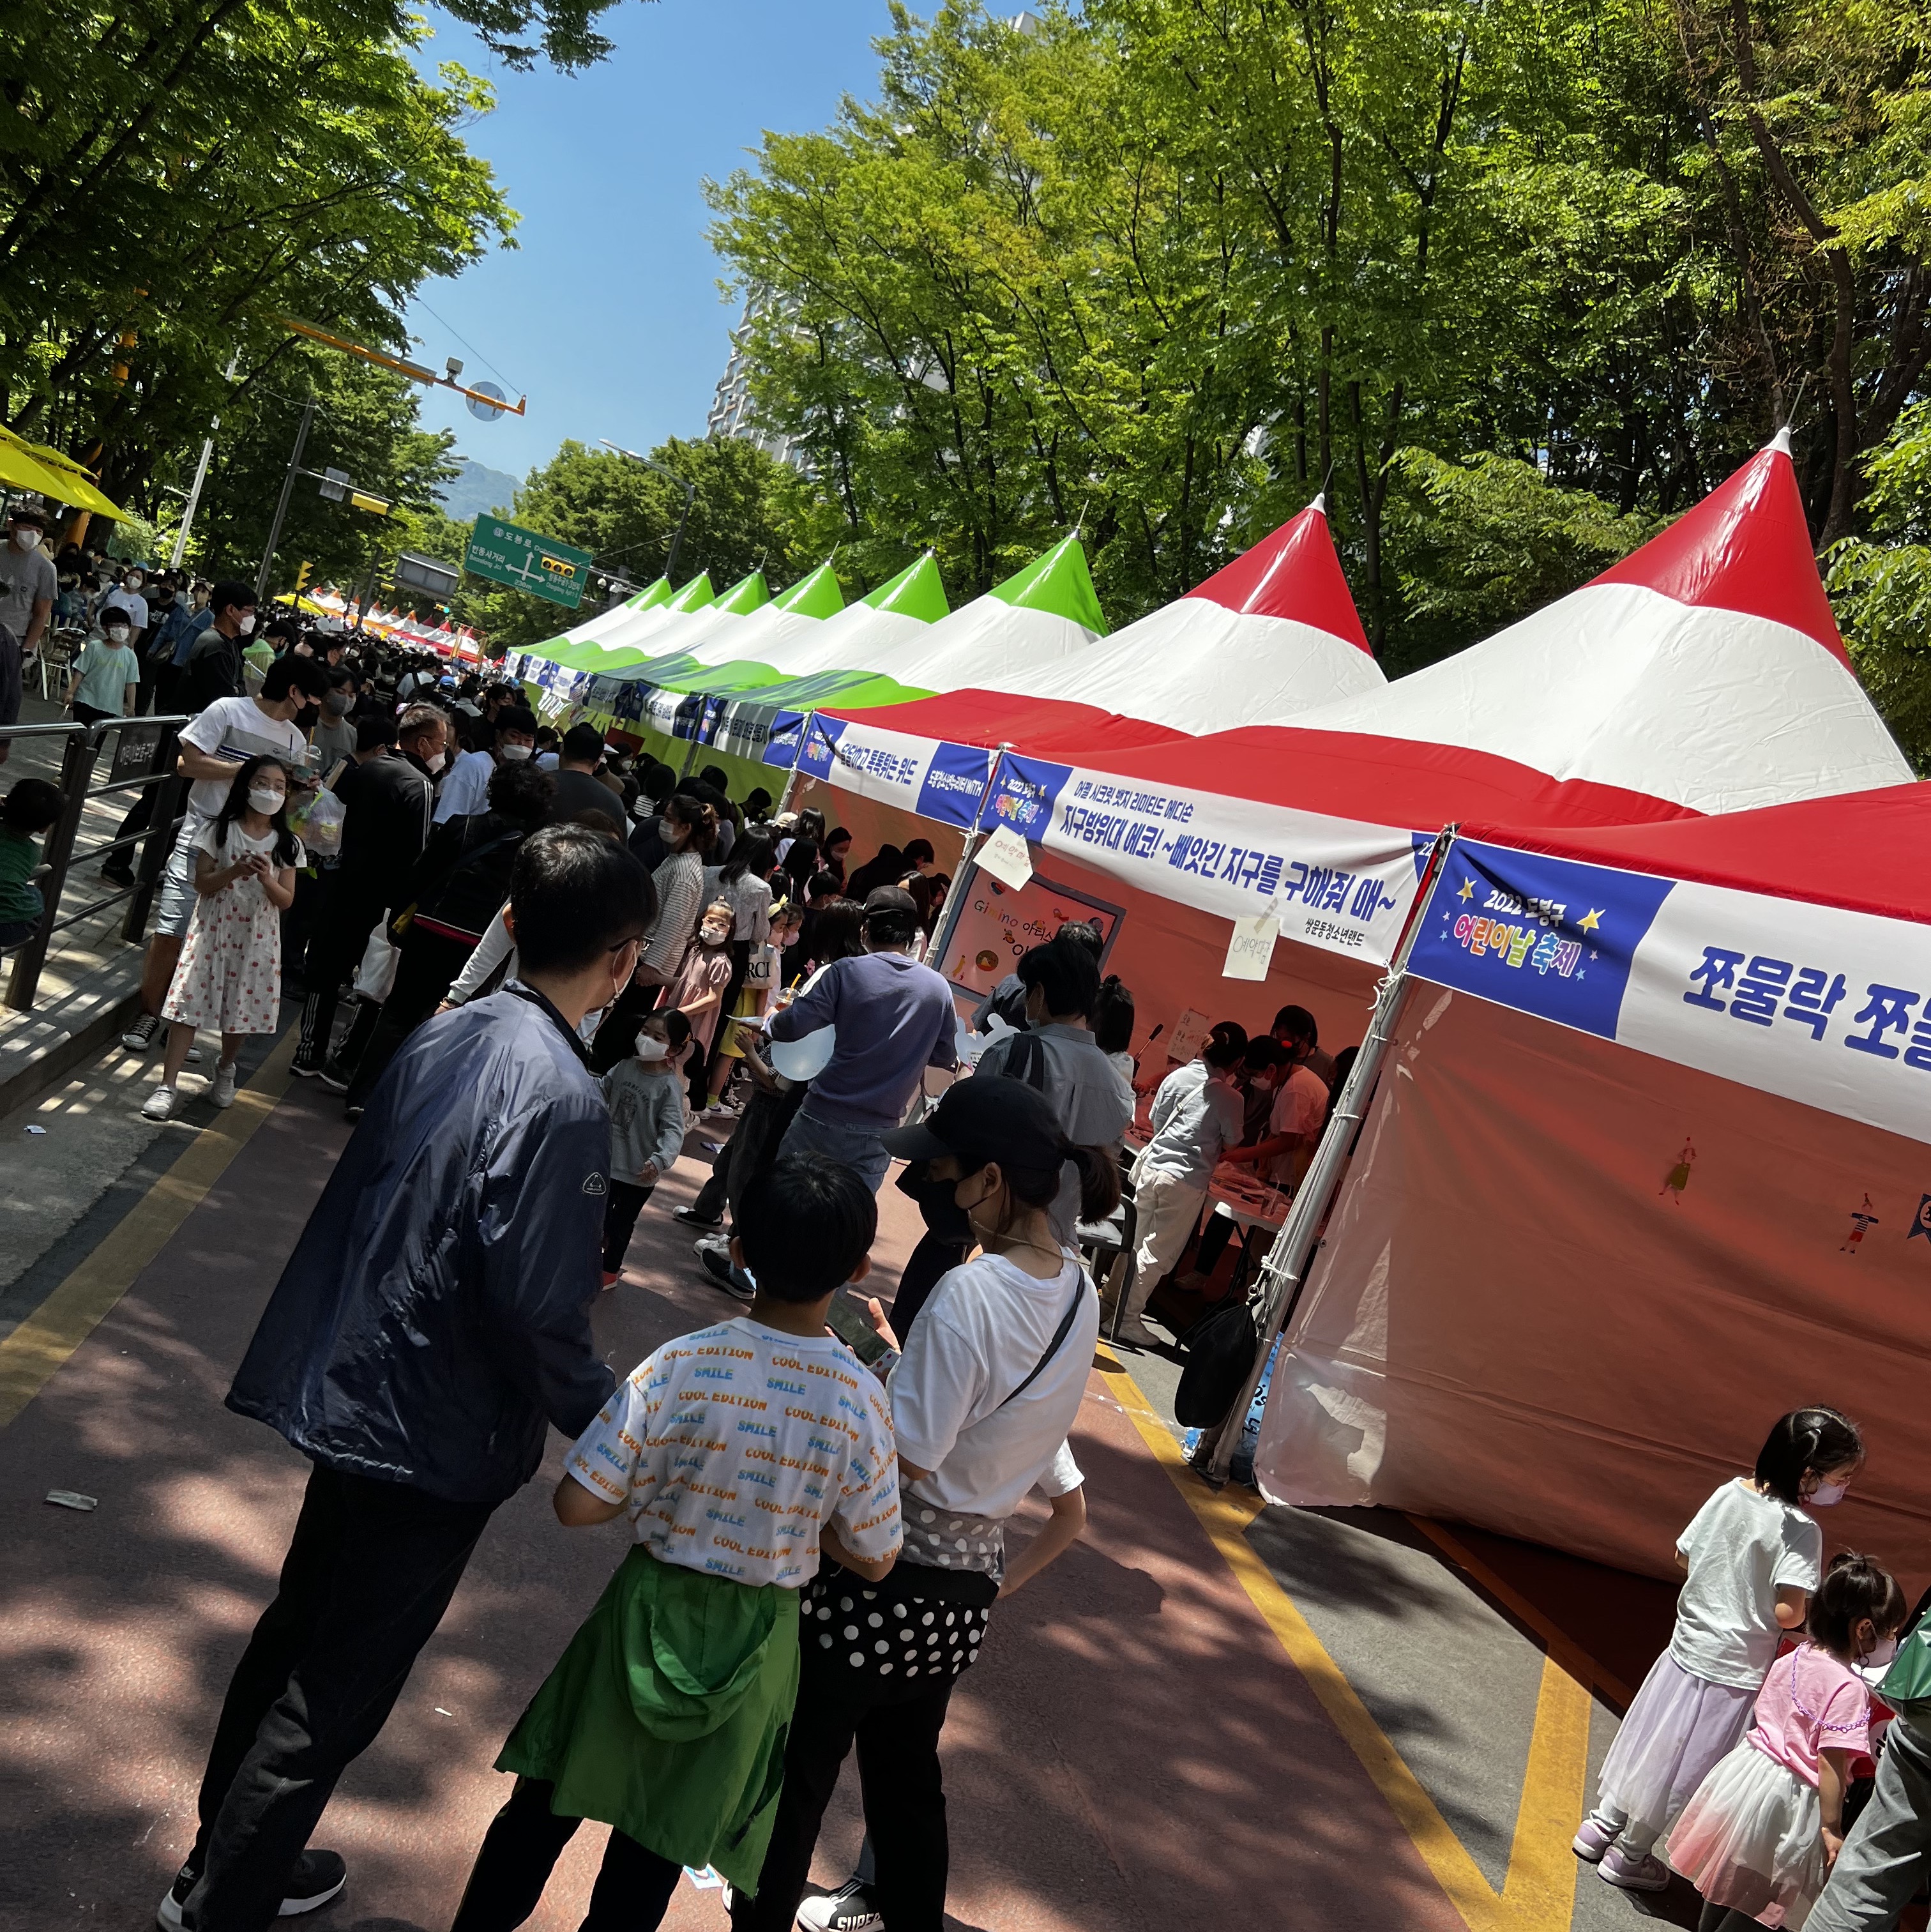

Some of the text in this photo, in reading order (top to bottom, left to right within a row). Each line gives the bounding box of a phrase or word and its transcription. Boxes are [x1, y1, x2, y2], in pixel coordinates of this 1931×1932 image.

[504, 531, 531, 548] 도봉로
[472, 545, 506, 564] 번동사거리
[866, 749, 898, 780] 톡톡튀는
[896, 757, 918, 785] 위드
[1089, 784, 1116, 805] 시크릿
[1130, 793, 1167, 816] 리미티드
[1163, 800, 1193, 823] 에디숀
[1059, 805, 1128, 850] 지구방위대
[1123, 822, 1165, 859] 에코!
[1220, 847, 1284, 896] 지구를
[1284, 861, 1356, 914] 구해줘
[1350, 878, 1397, 922] 매~
[1483, 889, 1567, 927] 2022 도봉구
[974, 900, 1054, 943] Gimino 아티스
[1305, 918, 1365, 947] 쌍문동청소년랜드
[1453, 913, 1582, 978] 어린이날 축제
[748, 962, 771, 978] RCI
[1683, 945, 1847, 1042] 쪼물락
[690, 1326, 730, 1341] SMILE
[664, 1346, 754, 1361] COOL EDITION
[694, 1367, 734, 1380] SMILE
[772, 1355, 858, 1390] COOL EDITION
[766, 1376, 806, 1396] SMILE
[678, 1390, 767, 1411] COOL EDITION
[838, 1395, 868, 1421] SMILE
[670, 1411, 705, 1424] SMILE
[785, 1406, 817, 1424] COOL
[738, 1420, 778, 1437] SMILE
[596, 1442, 629, 1473] SMILE
[746, 1447, 829, 1478] COOL EDITION
[738, 1469, 777, 1488] SMILE
[688, 1482, 737, 1501] DITION
[755, 1497, 784, 1514] COOL
[706, 1508, 746, 1527] SMILE
[853, 1503, 898, 1533] EDITION
[713, 1535, 745, 1554] COOL
[706, 1556, 746, 1576] SMILE
